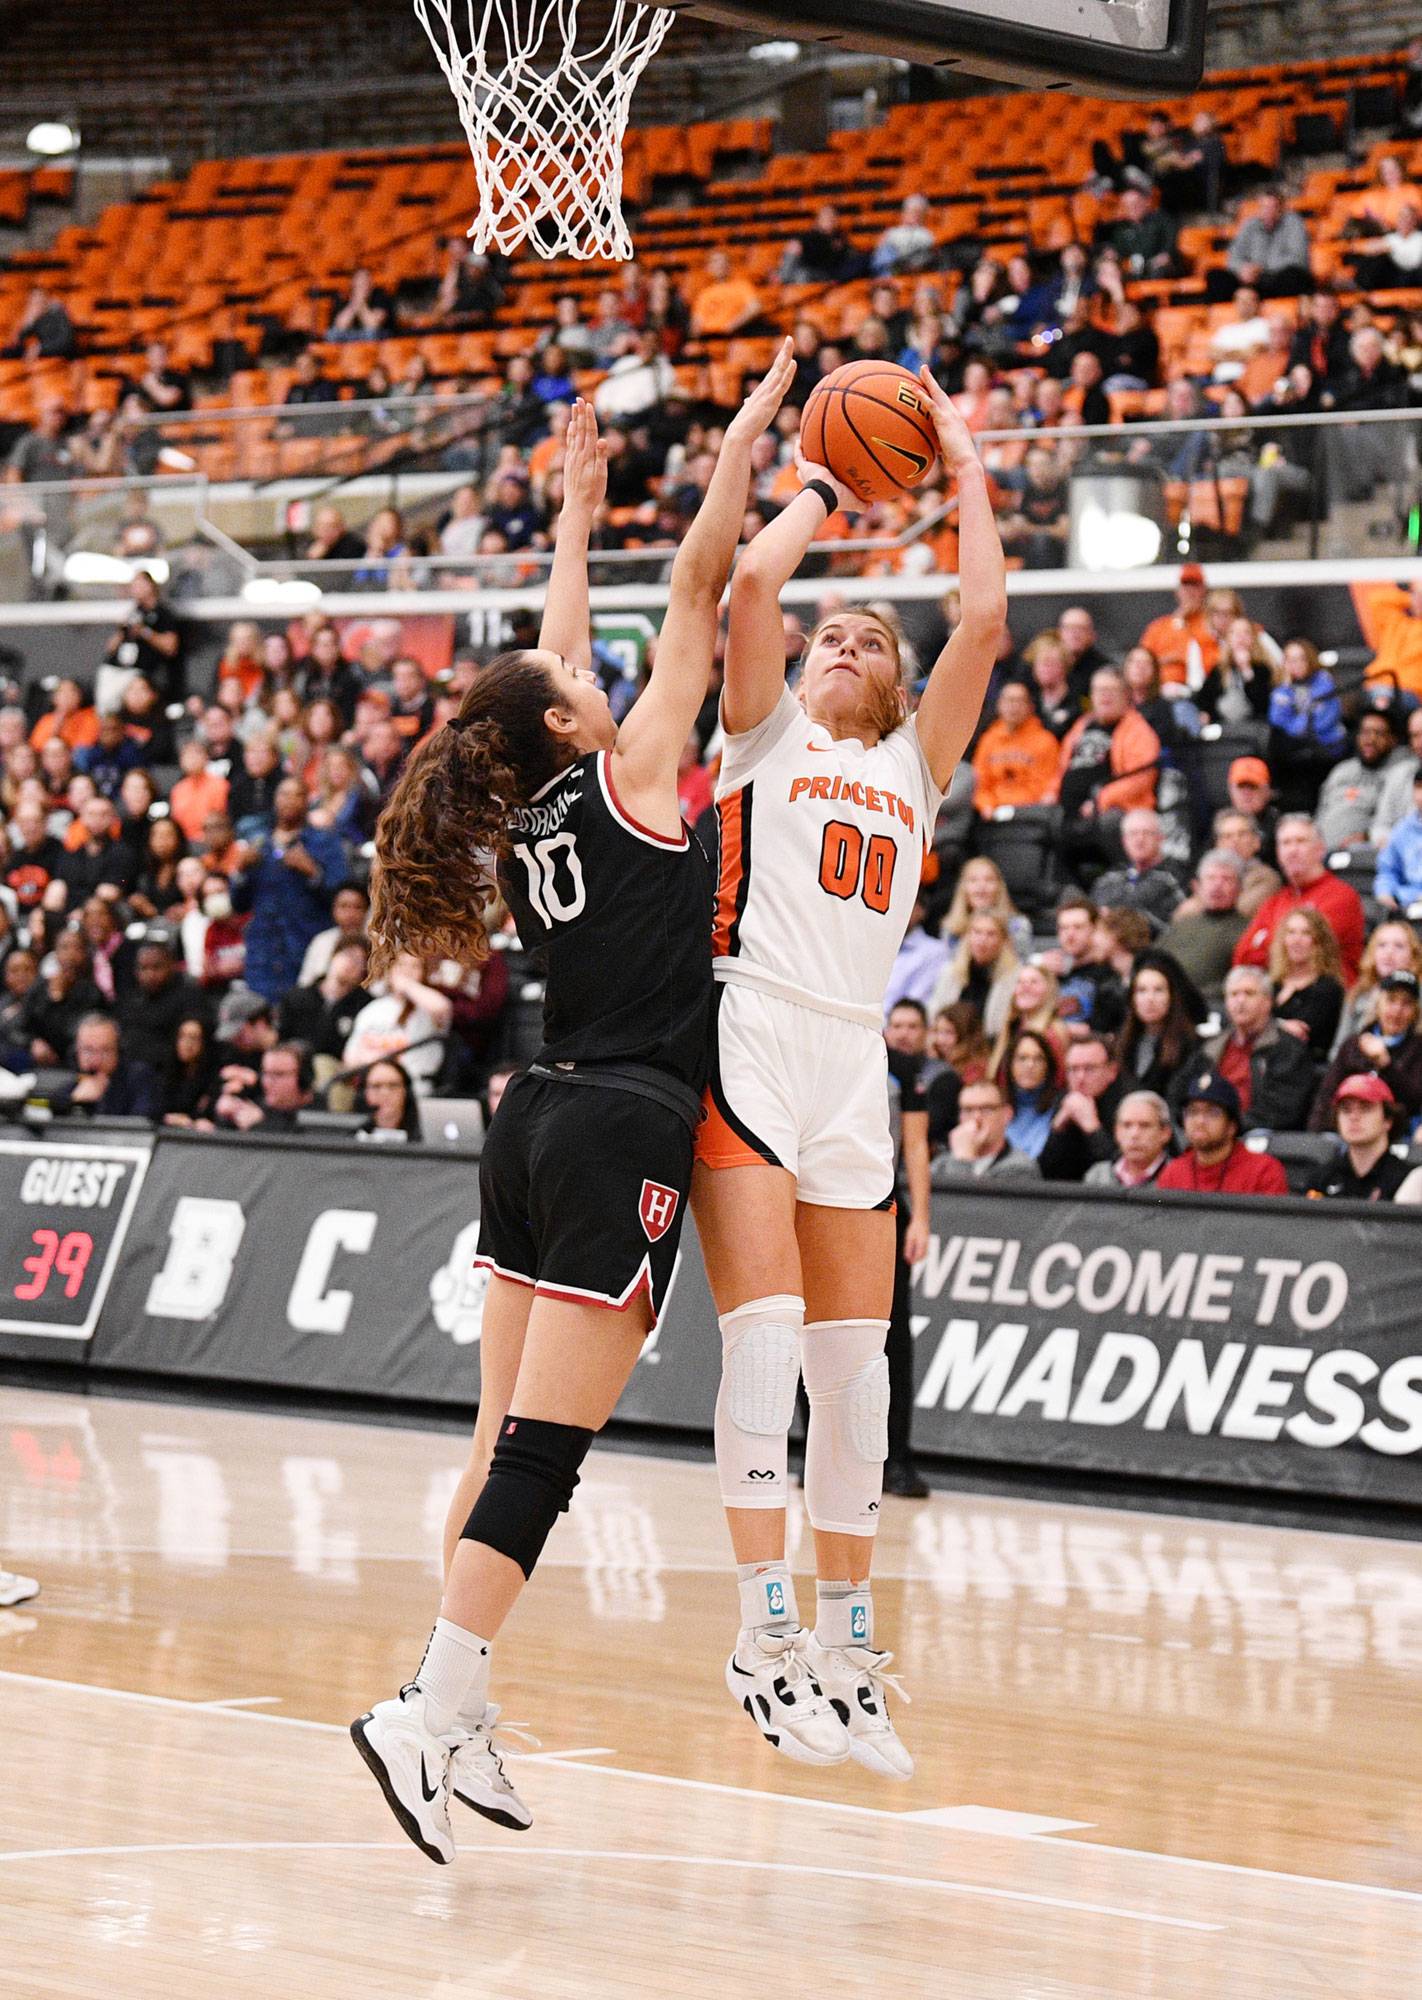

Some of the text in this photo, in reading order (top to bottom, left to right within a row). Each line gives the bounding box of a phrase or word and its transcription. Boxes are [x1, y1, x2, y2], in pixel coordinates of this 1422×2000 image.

[513, 832, 587, 930] 10
[818, 819, 898, 915] 00
[20, 1157, 126, 1208] GUEST
[645, 1189, 673, 1228] H
[14, 1229, 94, 1300] 39
[145, 1196, 378, 1335] B C
[909, 1233, 1349, 1331] WELCOME TO
[913, 1317, 1422, 1456] MADNESS
